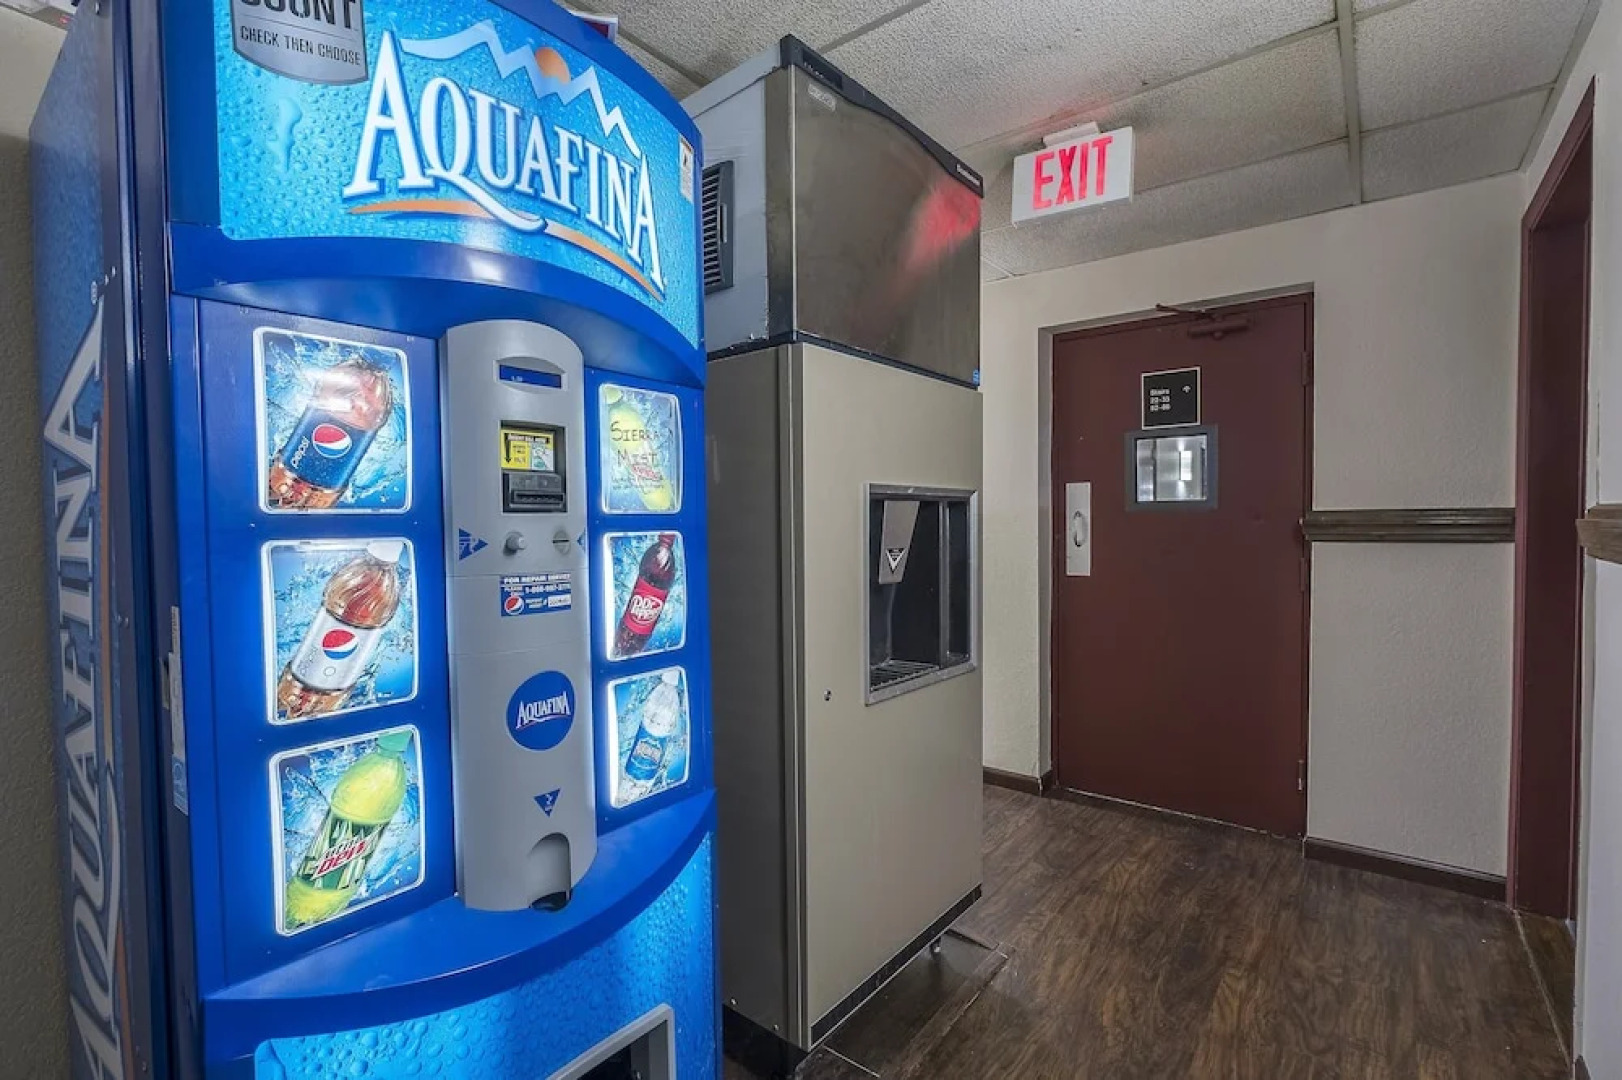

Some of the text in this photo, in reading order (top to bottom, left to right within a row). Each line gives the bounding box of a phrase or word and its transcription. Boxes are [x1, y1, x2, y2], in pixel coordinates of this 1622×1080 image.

[241, 0, 356, 29] UNT
[240, 25, 361, 66] CHECK THEN CHOOSE
[343, 31, 666, 287] AQUAFINA
[1033, 136, 1114, 210] EXIT
[610, 420, 660, 442] SIERRA
[291, 436, 310, 470] pepsi
[516, 691, 572, 729] AQUAFINA
